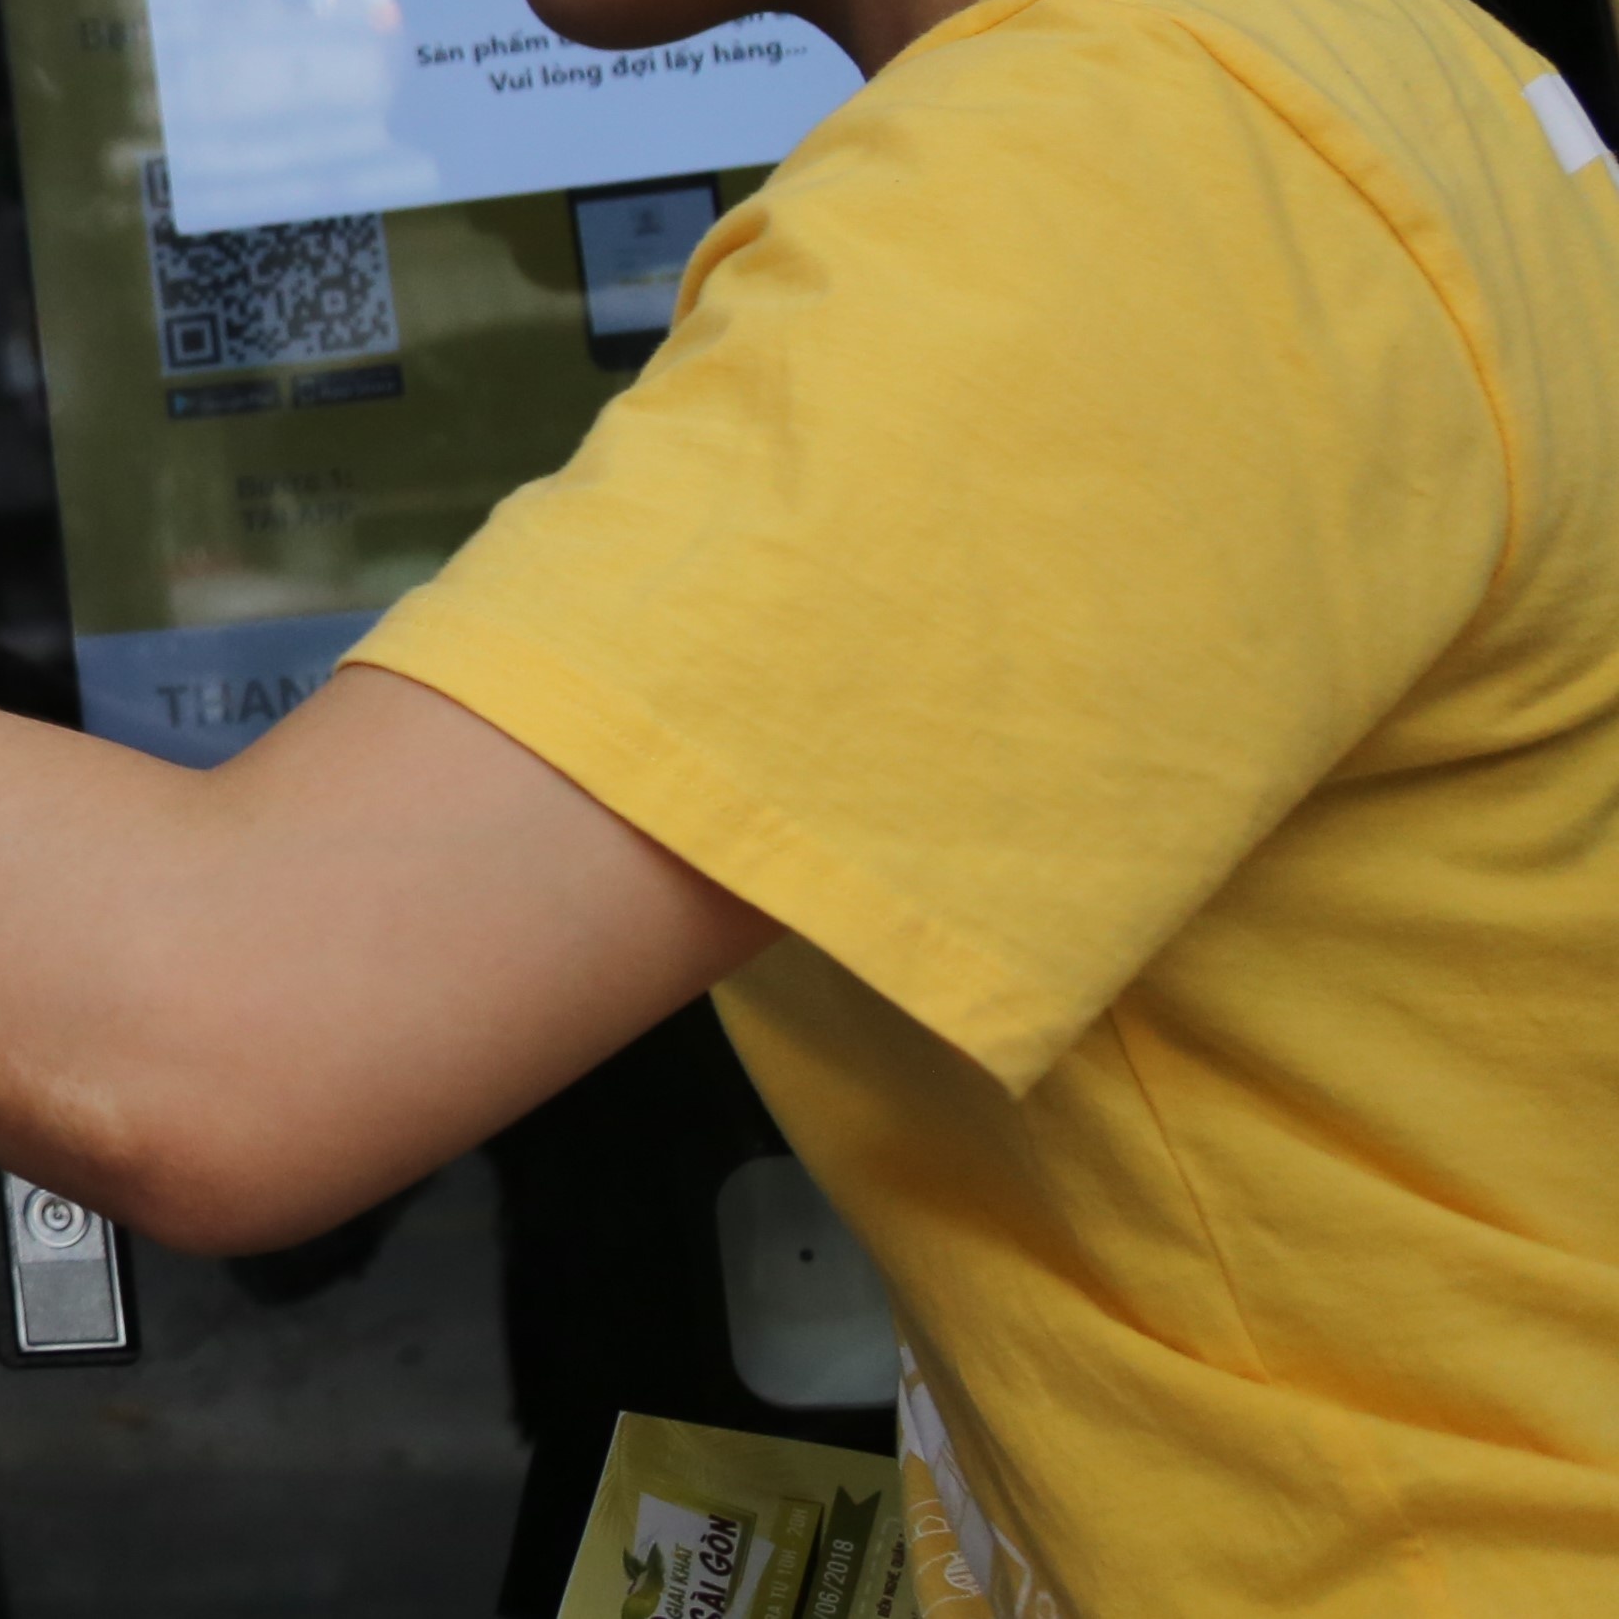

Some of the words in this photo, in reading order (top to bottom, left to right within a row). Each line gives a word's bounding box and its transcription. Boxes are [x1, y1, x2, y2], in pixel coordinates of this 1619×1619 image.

[489, 67, 533, 93] Vui
[543, 61, 603, 88] lòng
[611, 51, 657, 79] đợi
[156, 672, 332, 728] THAN
[699, 1514, 738, 1577] GÒN
